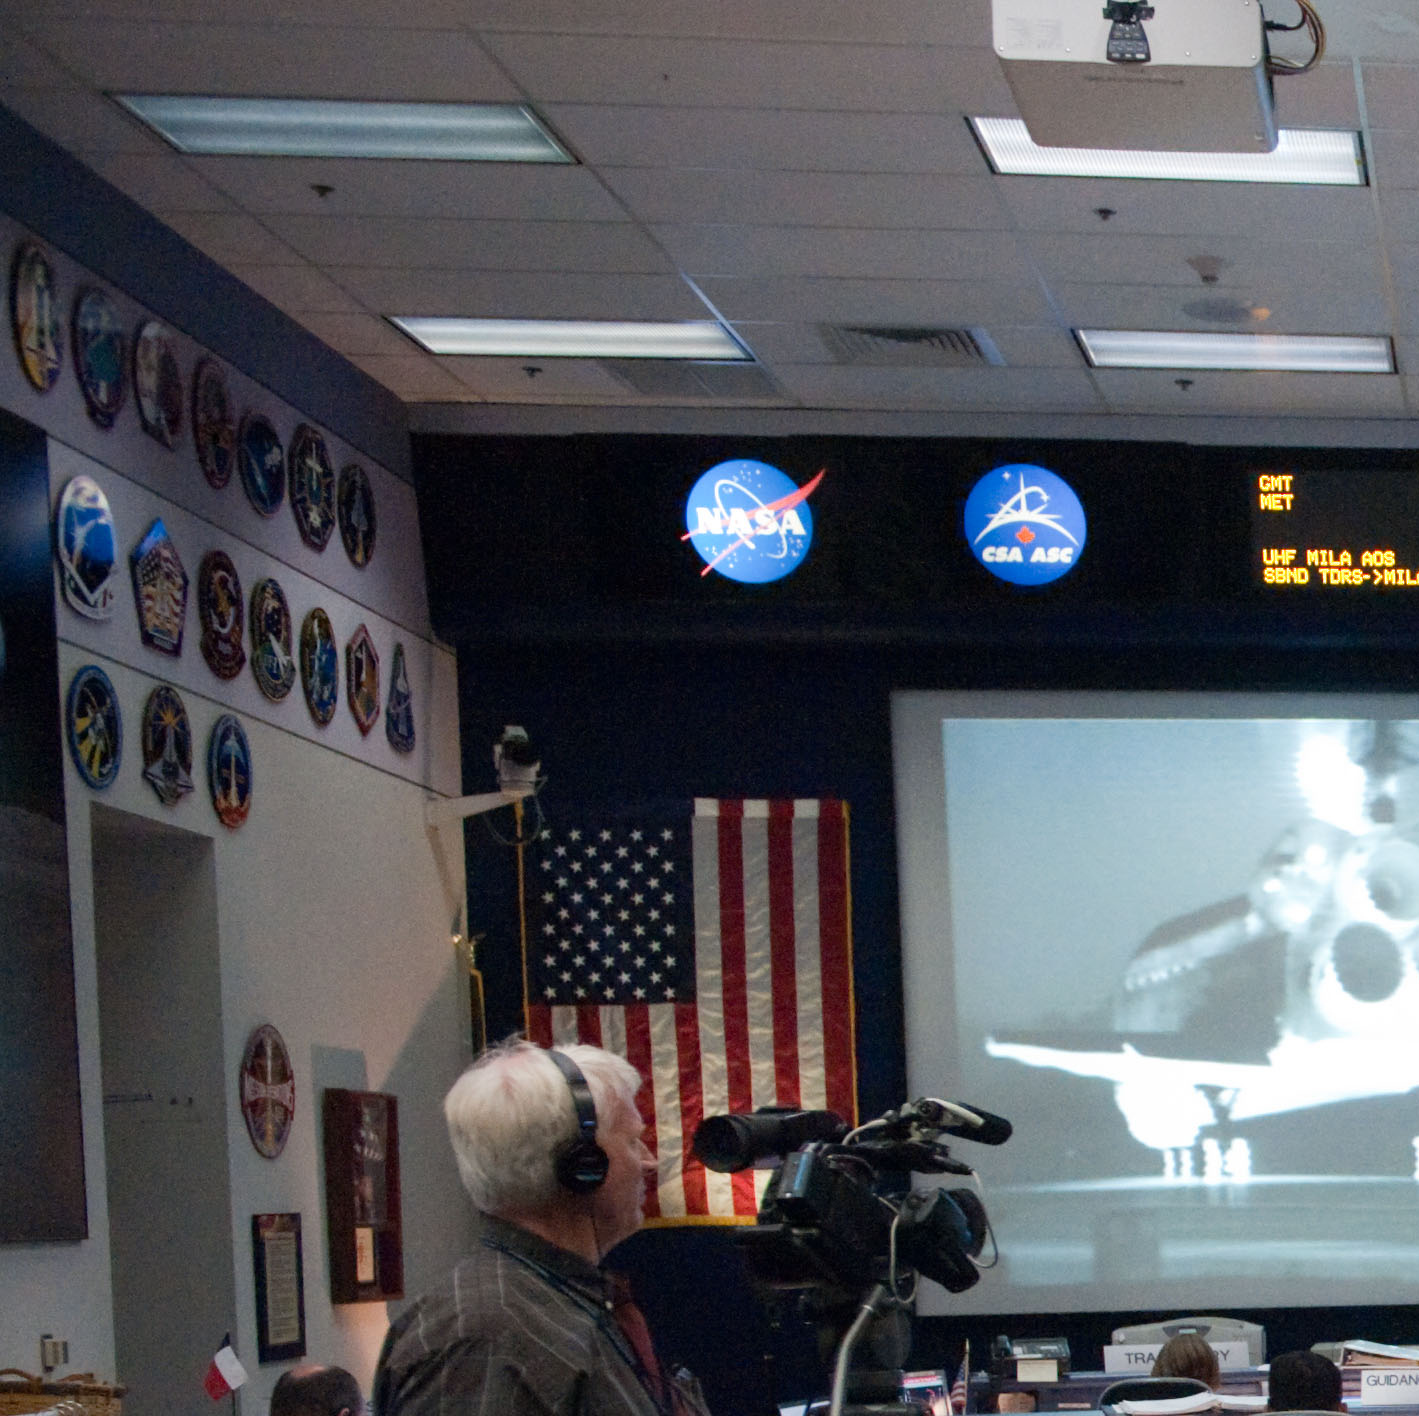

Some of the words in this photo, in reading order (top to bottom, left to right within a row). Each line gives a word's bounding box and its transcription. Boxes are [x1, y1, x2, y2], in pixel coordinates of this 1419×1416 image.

[1258, 475, 1294, 492] GMT
[1260, 494, 1295, 511] MET
[695, 507, 807, 536] NASA
[981, 546, 1024, 563] CSA
[1029, 546, 1074, 564] ASC
[1261, 549, 1297, 566] UHF
[1306, 549, 1352, 567] MILA
[1360, 550, 1396, 567] AOS
[1263, 567, 1309, 585] SBND
